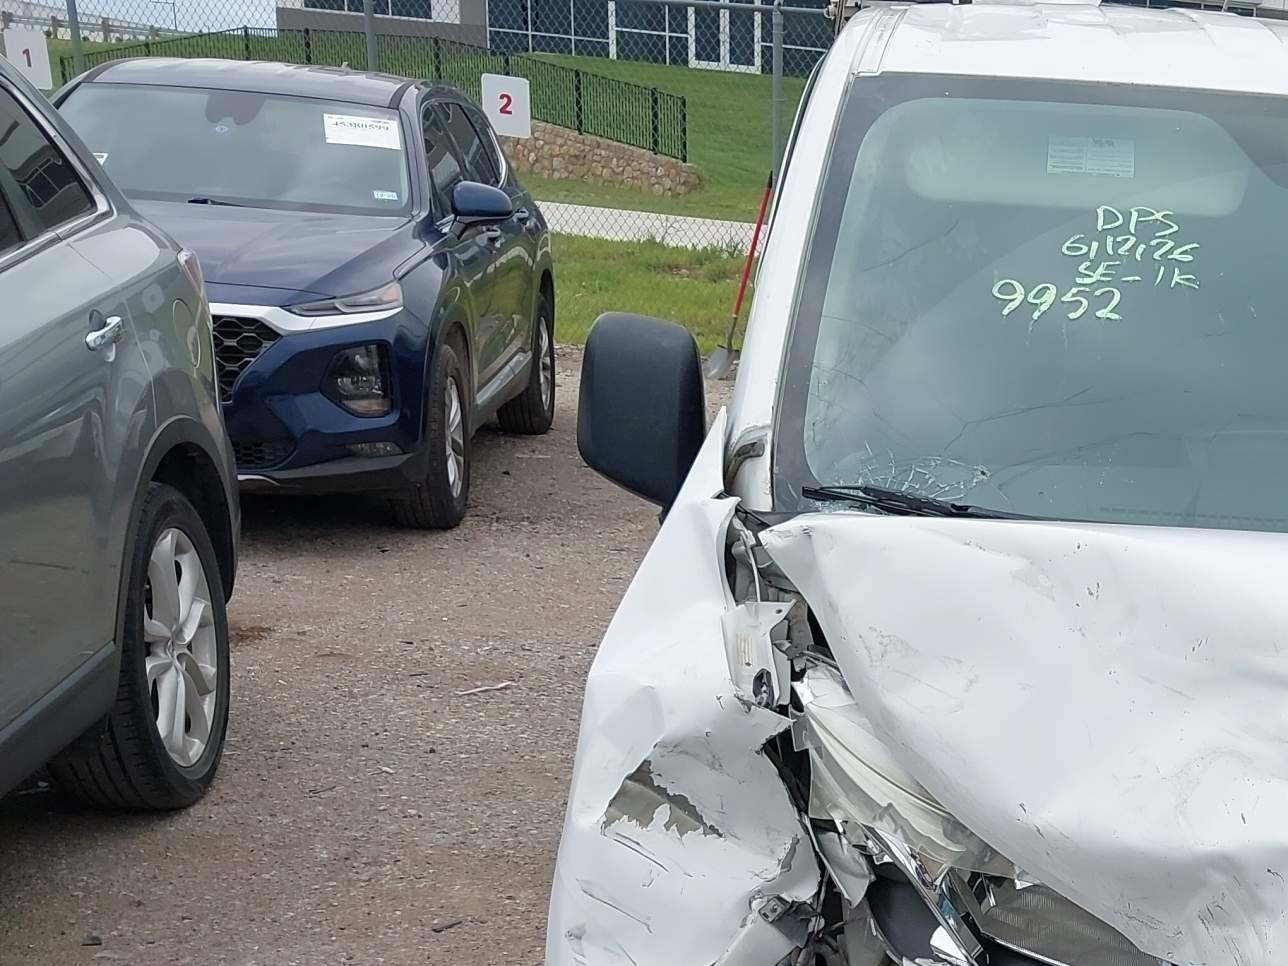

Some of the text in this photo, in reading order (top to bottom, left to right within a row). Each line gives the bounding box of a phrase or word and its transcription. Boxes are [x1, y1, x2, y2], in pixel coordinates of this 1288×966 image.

[22, 48, 32, 68] 1
[499, 93, 513, 115] 2
[1097, 206, 1179, 236] DPS
[992, 279, 1123, 321] 9952
